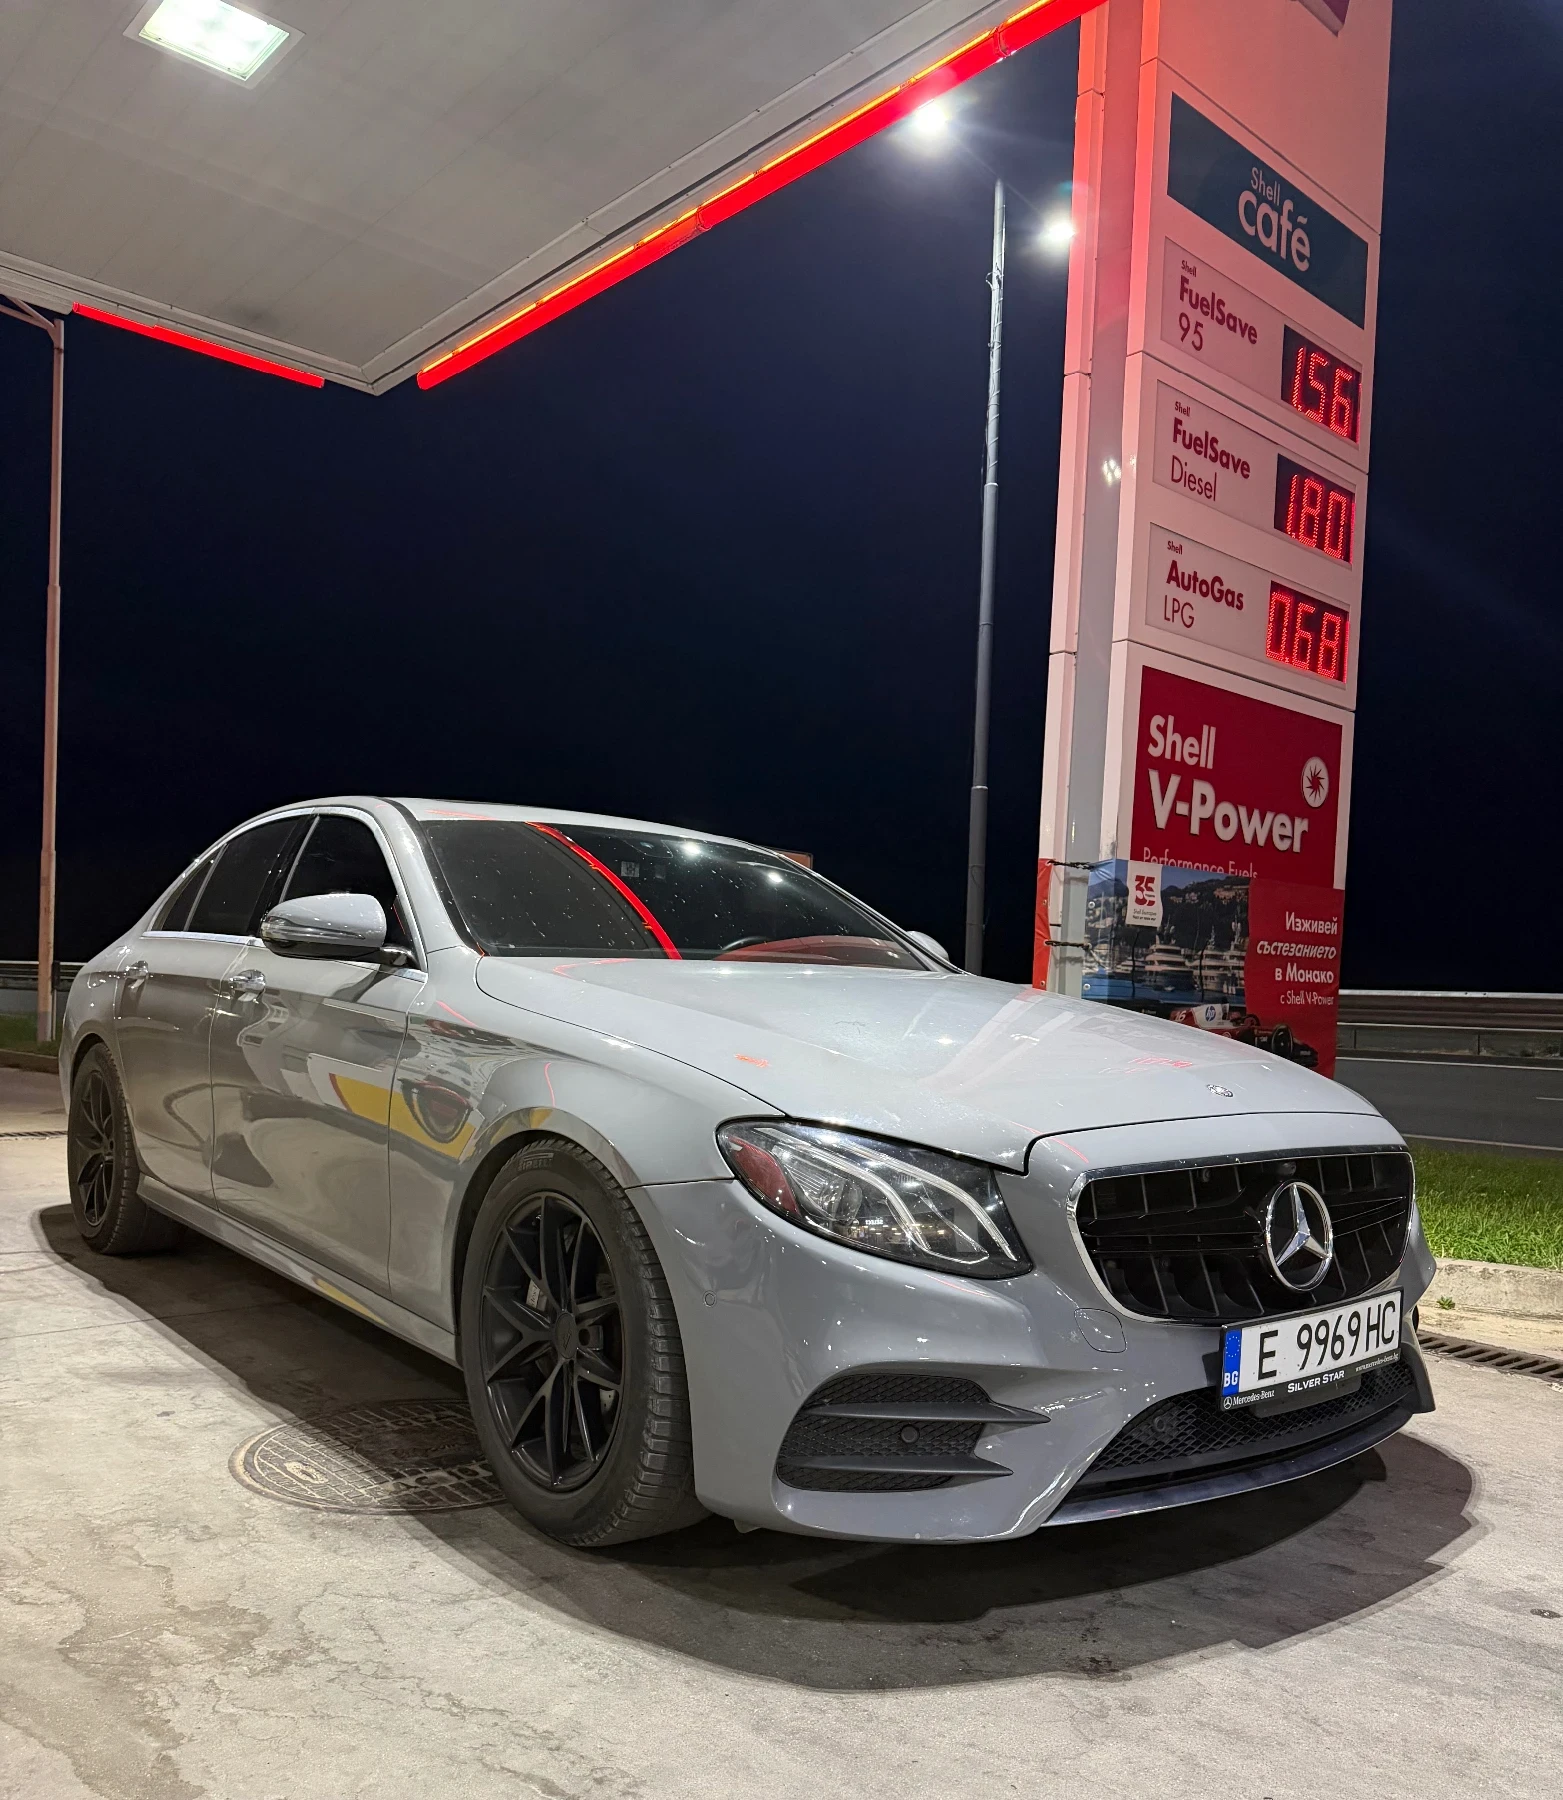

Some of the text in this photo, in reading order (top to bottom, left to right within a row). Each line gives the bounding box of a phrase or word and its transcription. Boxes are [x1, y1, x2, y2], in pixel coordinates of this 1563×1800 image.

[1250, 167, 1281, 206] Shell
[1238, 190, 1311, 272] café
[1181, 260, 1197, 278] Shell
[1179, 275, 1258, 345] FuelSave
[1178, 313, 1204, 352] 95
[1174, 401, 1191, 417] Shell
[1173, 417, 1251, 479] FuelSave
[1171, 455, 1217, 502] Diesel
[1167, 540, 1183, 555] Shell
[1166, 559, 1244, 611] AutoGas
[1164, 594, 1195, 629] LPG
[1147, 714, 1217, 769] Shell
[1148, 768, 1309, 853] V-Power
[1285, 911, 1338, 935] Изживей
[1256, 940, 1337, 959] състезанието
[1275, 962, 1335, 983] в Монако
[1286, 989, 1305, 1005] Shell
[1257, 1329, 1278, 1381] E
[1223, 1371, 1239, 1388] BG
[1232, 1390, 1275, 1406] Mercedes-Benz
[1287, 1377, 1321, 1393] SILVER
[1322, 1370, 1345, 1384] STAR
